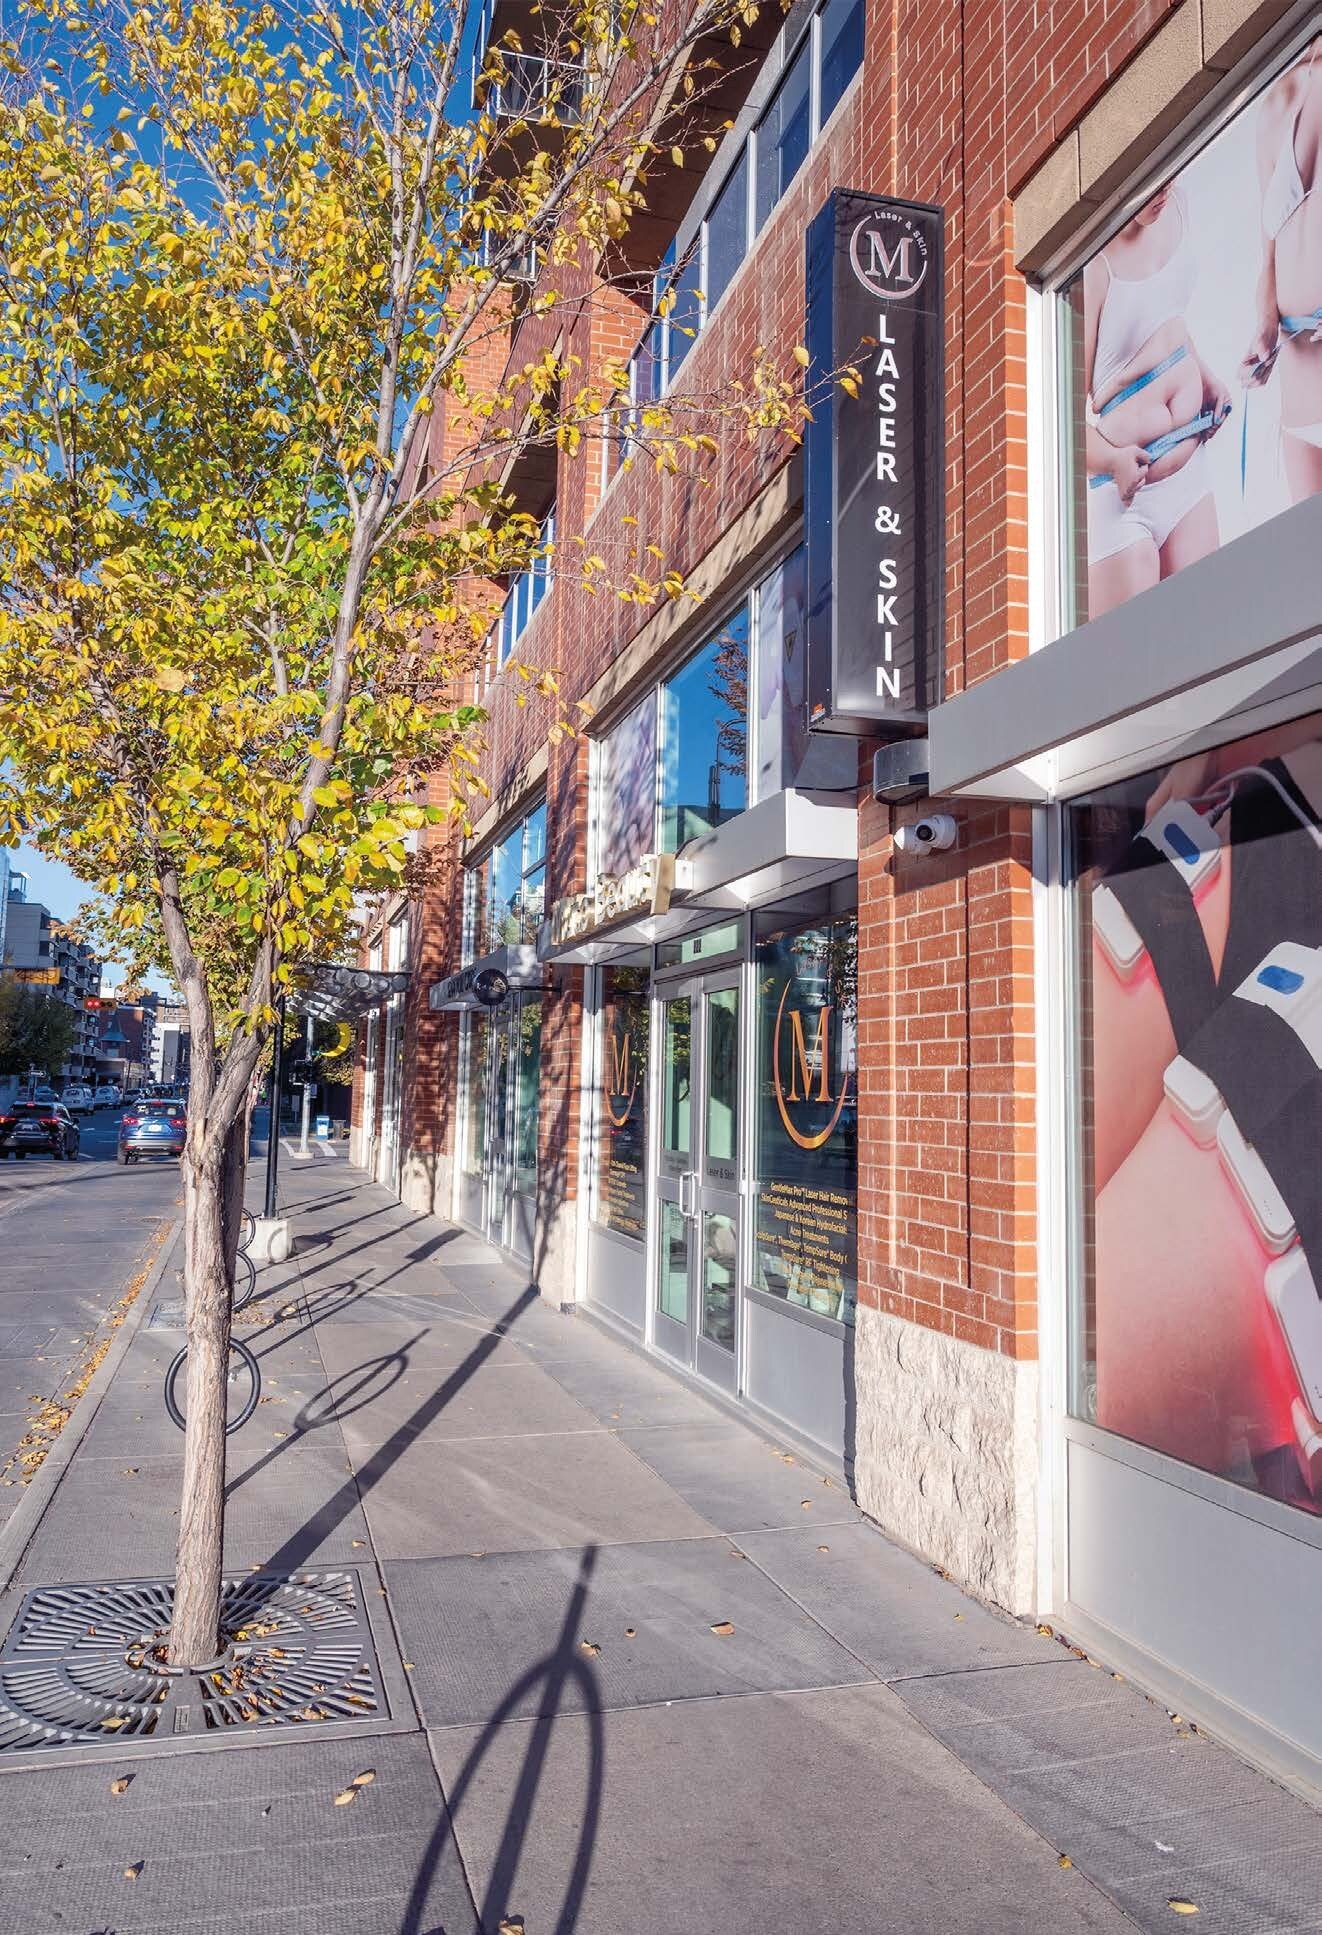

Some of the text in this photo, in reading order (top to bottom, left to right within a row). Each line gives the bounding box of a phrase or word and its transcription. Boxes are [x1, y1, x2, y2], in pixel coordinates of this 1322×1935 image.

[874, 211, 928, 256] Laser & Skin
[865, 231, 914, 282] M
[875, 314, 901, 698] LASER & SKIN
[786, 1006, 834, 1101] M
[805, 1188, 818, 1200] Laser
[818, 1190, 830, 1202] Hair
[812, 1203, 842, 1219] Professional
[829, 1249, 844, 1265] Body
